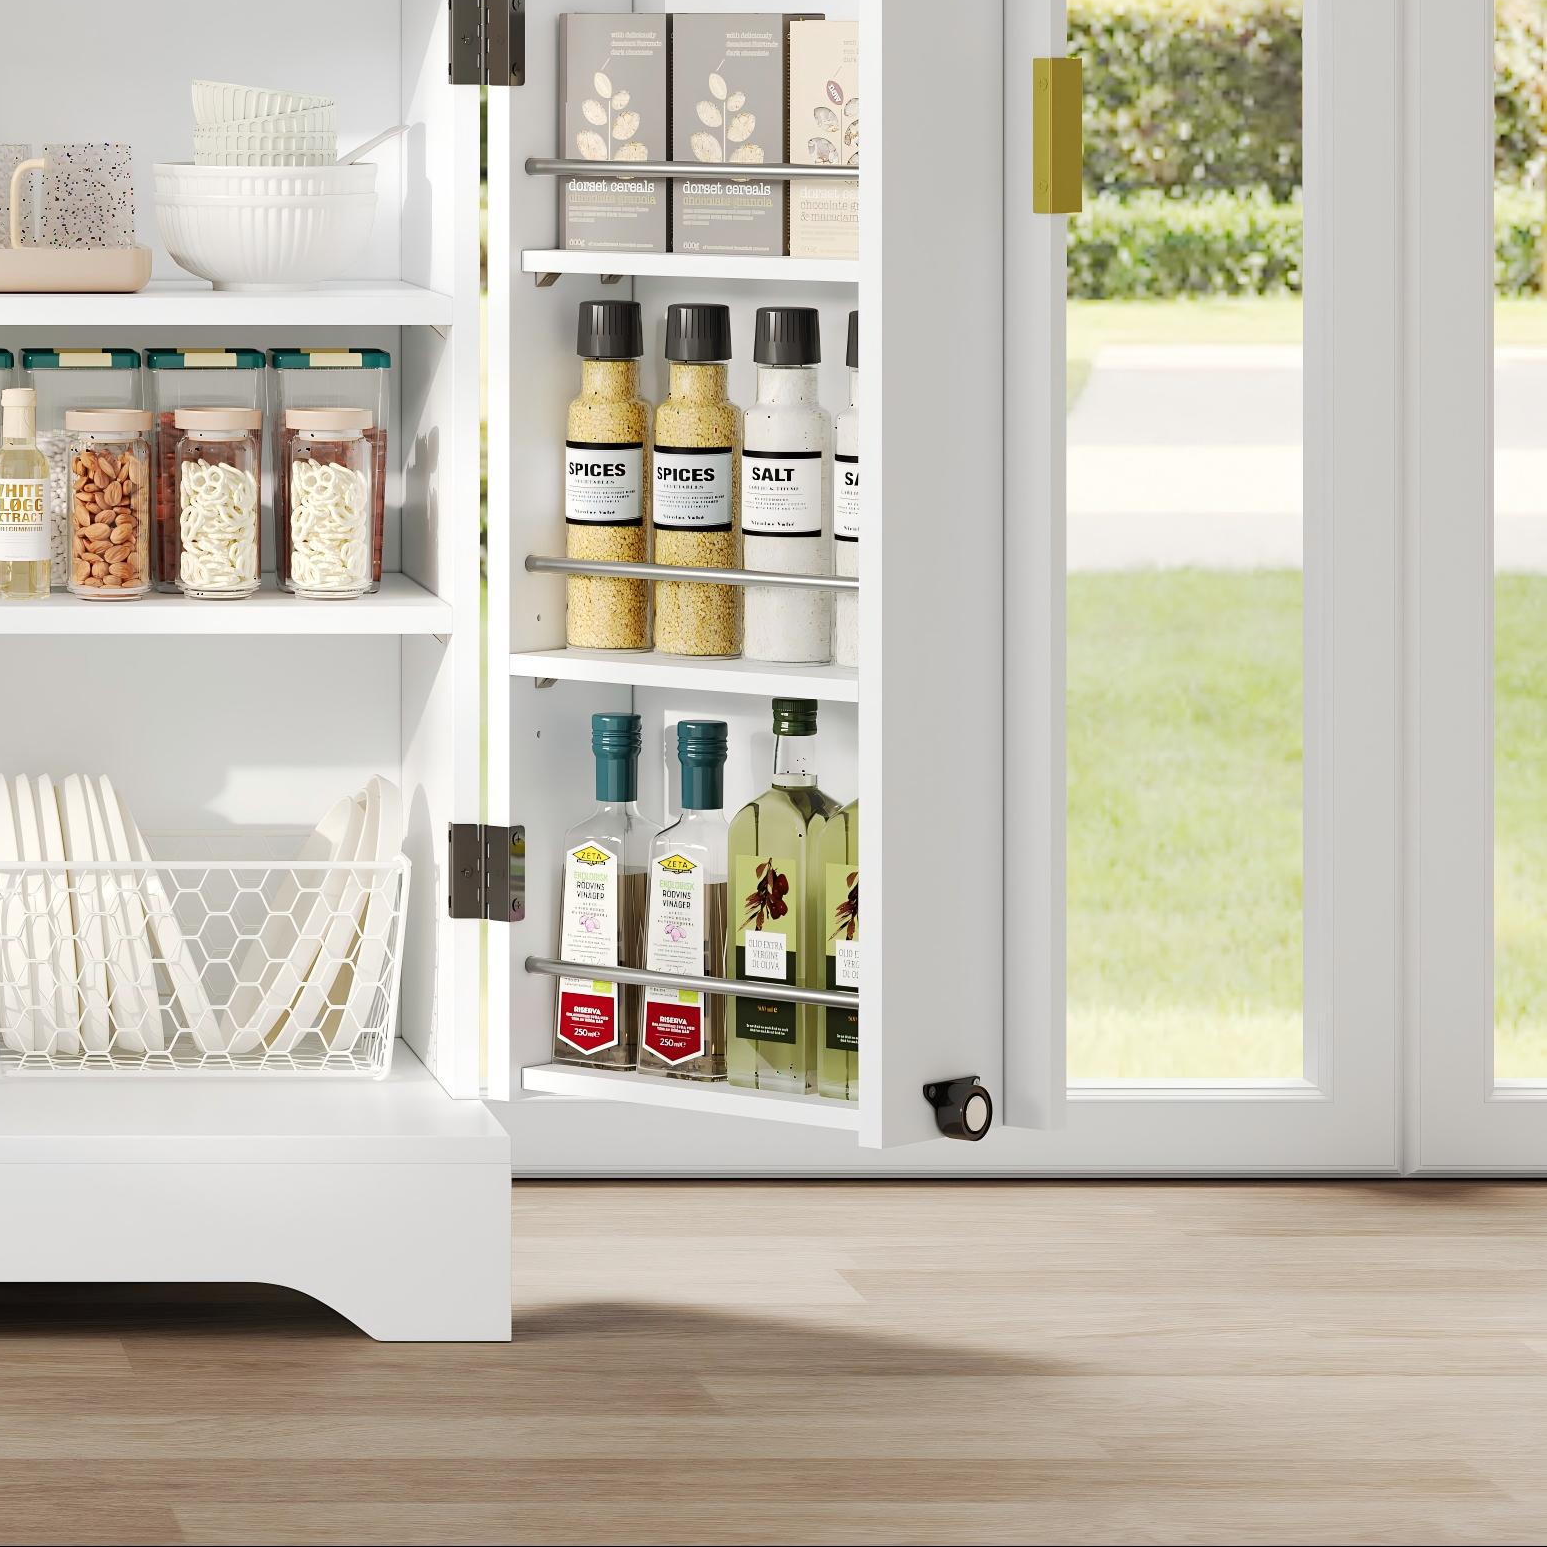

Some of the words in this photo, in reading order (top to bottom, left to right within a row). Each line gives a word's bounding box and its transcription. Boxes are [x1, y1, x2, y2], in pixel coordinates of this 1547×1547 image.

[569, 179, 607, 192] dorset
[610, 180, 654, 193] cereals
[683, 181, 722, 194] dorset
[726, 182, 770, 195] cereals
[569, 462, 625, 476] SPICES
[657, 466, 714, 481] SPICES
[752, 467, 795, 481] SALT
[581, 851, 602, 860] ZETA
[667, 860, 688, 868] ZETA
[748, 939, 762, 948] OLIO
[763, 941, 783, 950] EXTRA
[752, 950, 779, 960] VERGINE
[838, 948, 853, 957] OLIO
[761, 961, 780, 970] OLIVA
[573, 1005, 601, 1015] RISERVA
[659, 1015, 687, 1025] RISERVA
